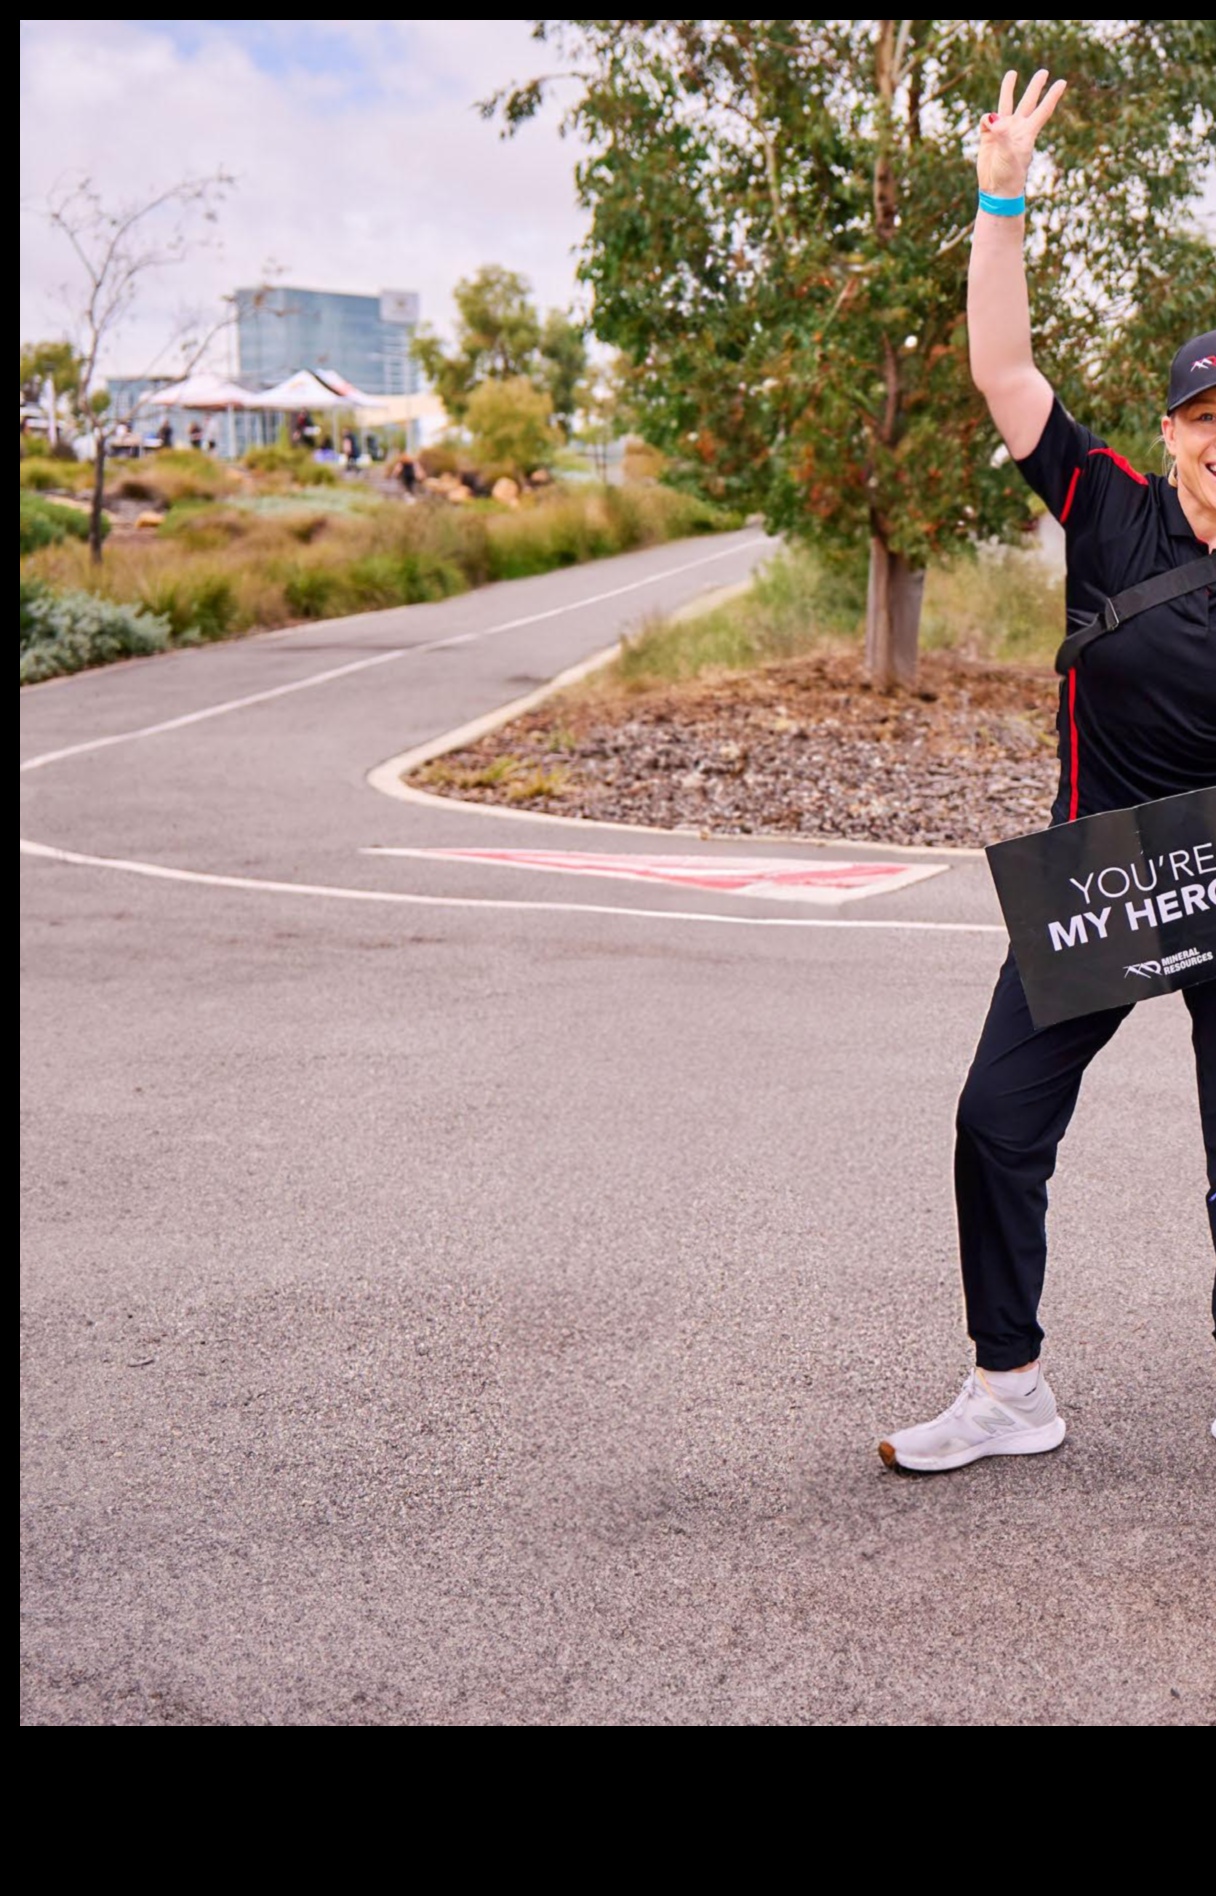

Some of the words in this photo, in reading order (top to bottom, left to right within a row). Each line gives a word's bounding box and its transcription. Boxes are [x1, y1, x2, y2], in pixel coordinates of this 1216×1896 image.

[1048, 906, 1112, 951] MY
[1161, 947, 1200, 967] MINERAL
[1163, 951, 1213, 976] RESOURCES
